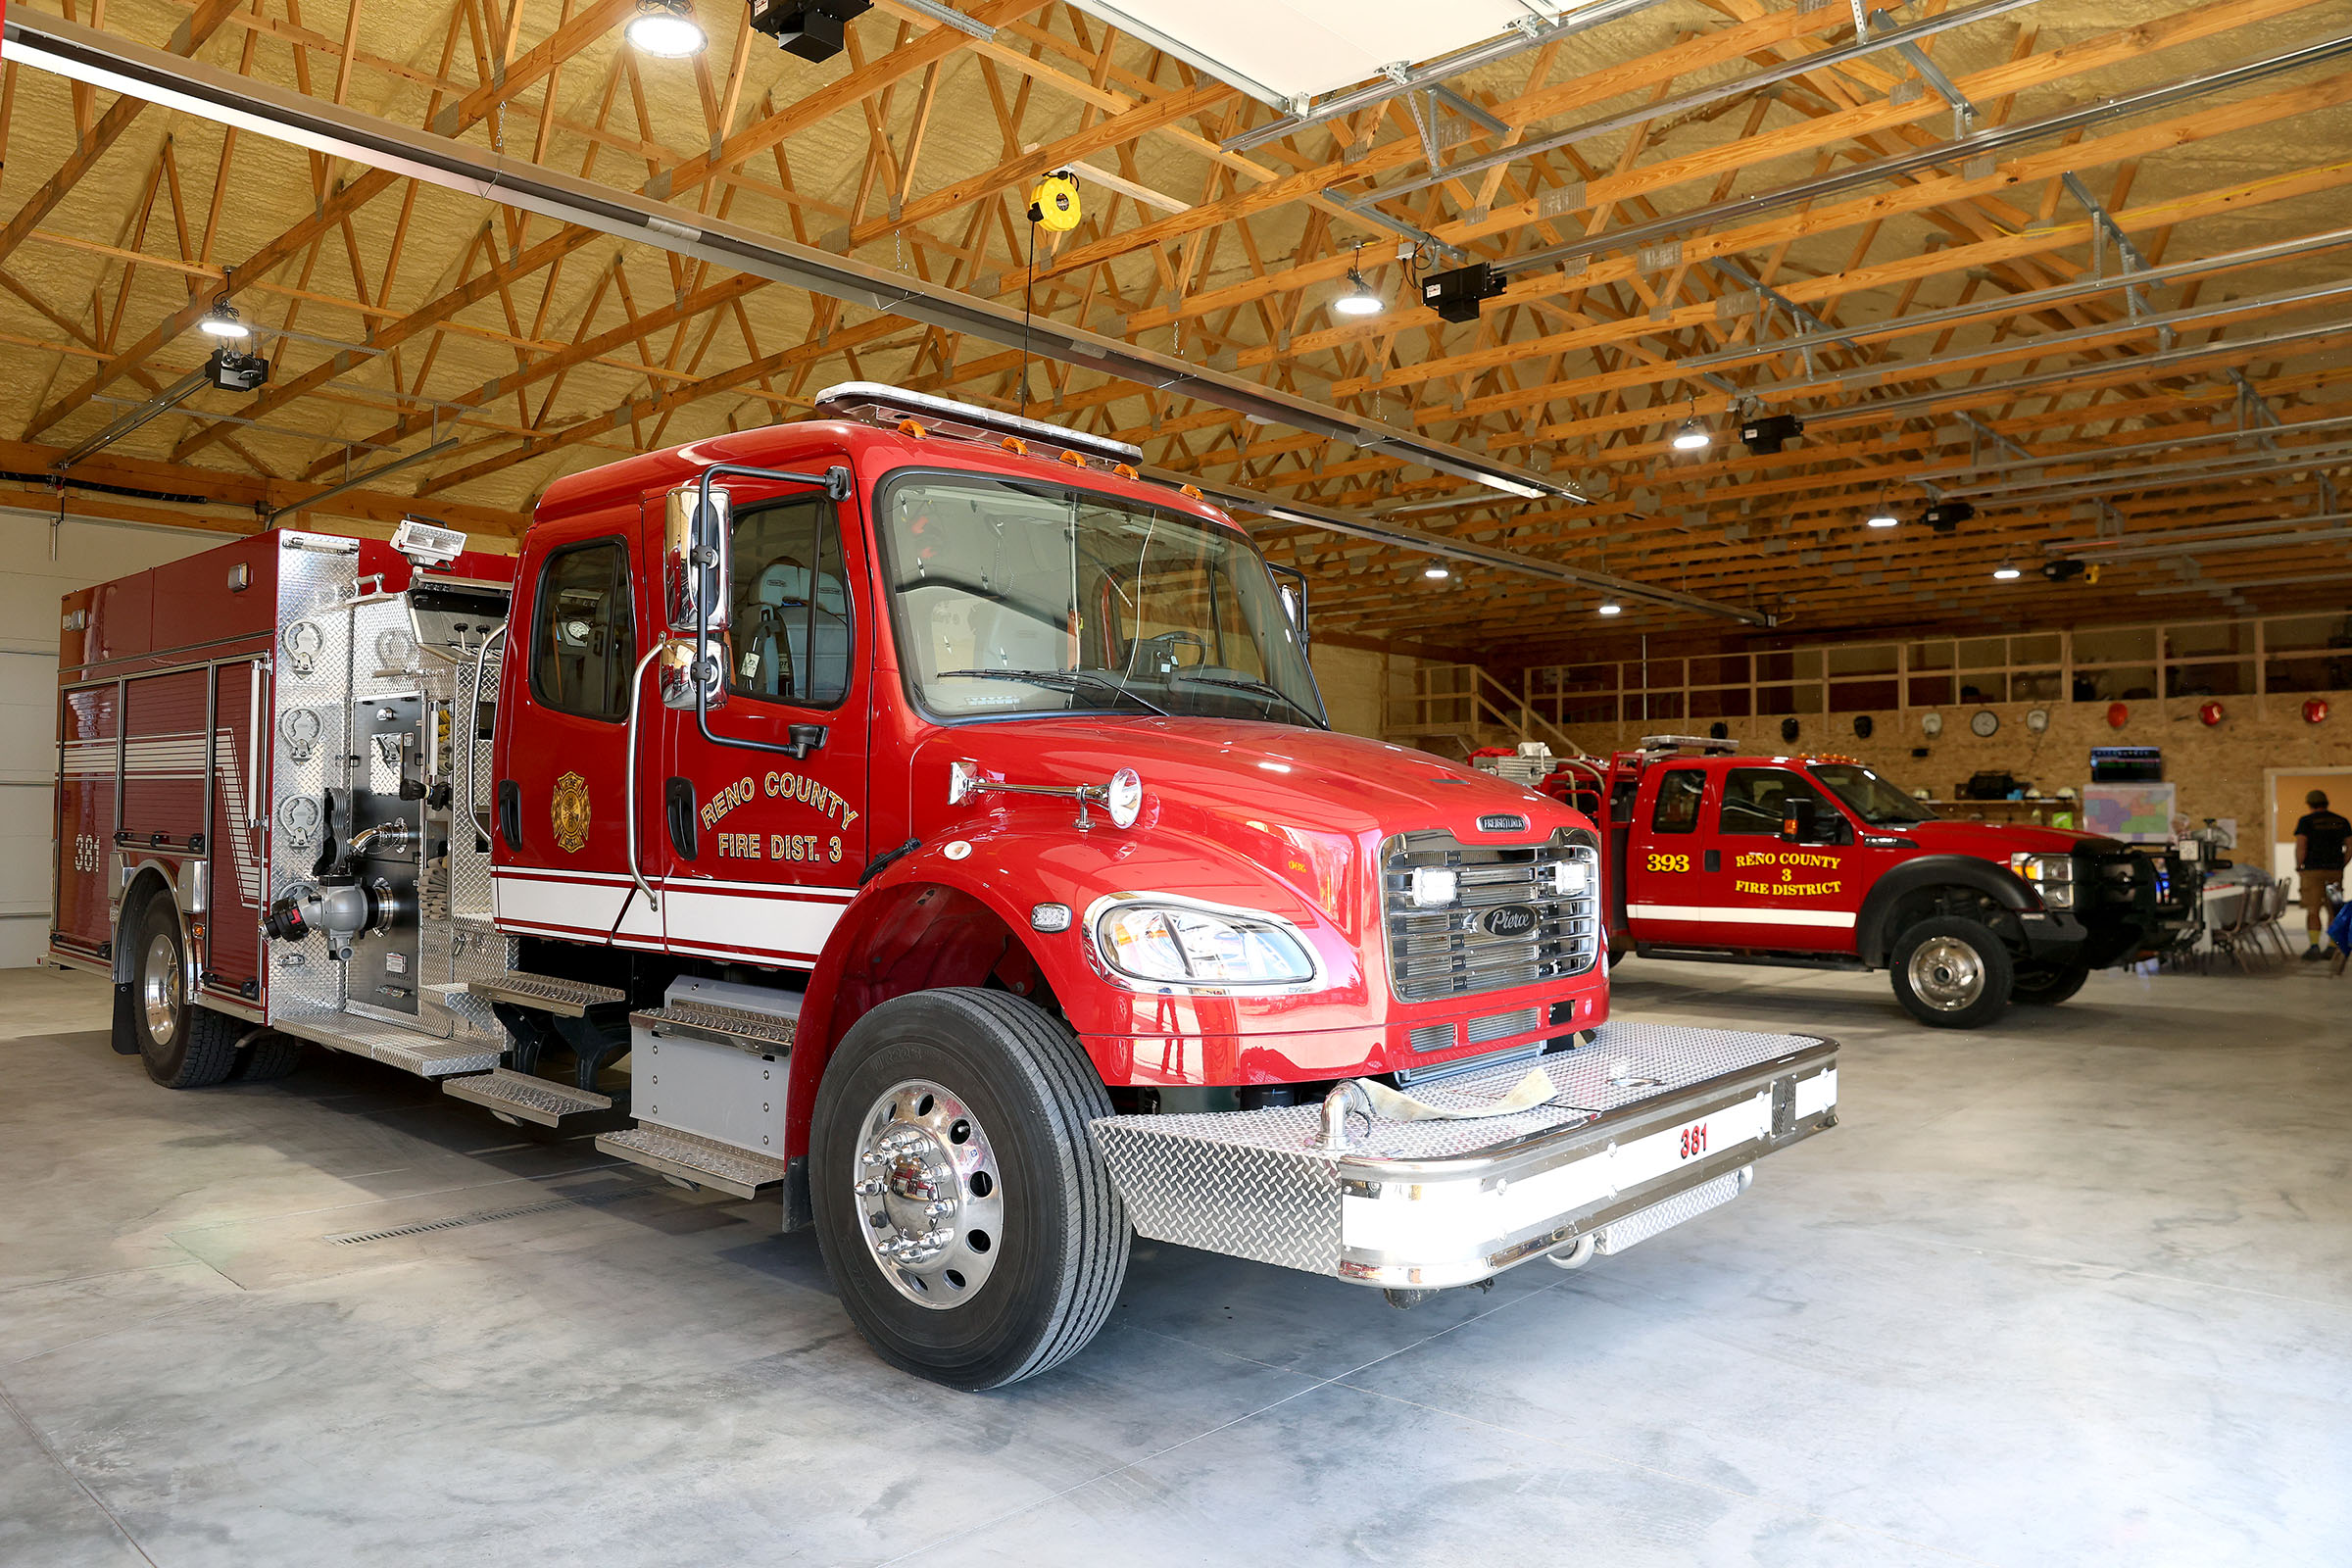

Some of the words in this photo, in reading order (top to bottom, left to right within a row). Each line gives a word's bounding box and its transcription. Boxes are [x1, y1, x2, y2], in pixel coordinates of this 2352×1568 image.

[700, 776, 755, 830] RENO
[764, 771, 858, 830] COUNTY
[74, 833, 100, 872] 381
[718, 833, 760, 858] FIRE
[770, 834, 820, 861] DIST.
[829, 836, 842, 862] 3
[1646, 854, 1690, 872] 393
[1736, 853, 1776, 867] RENO
[1779, 853, 1841, 869] COUNTY
[1735, 880, 1769, 895] FIRE
[1772, 880, 1841, 896] DISTRICT
[1782, 868, 1791, 882] 3
[1491, 908, 1530, 934] Pierce
[1681, 1122, 1707, 1159] 381
